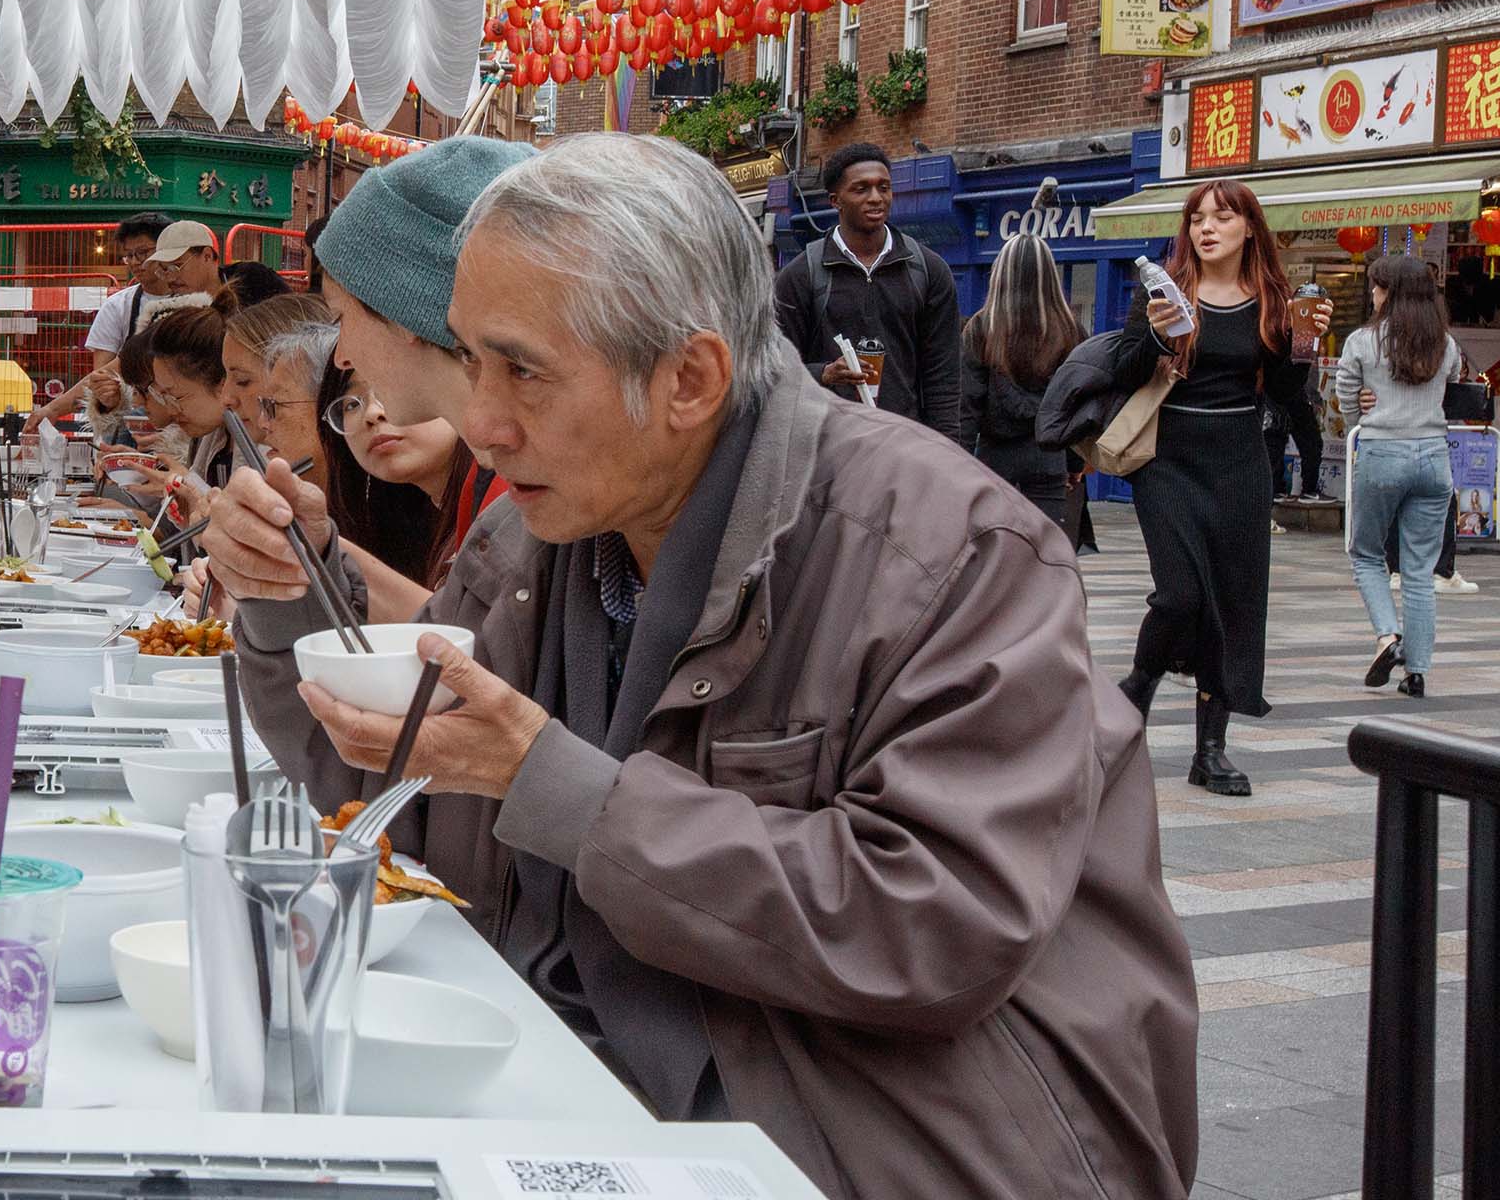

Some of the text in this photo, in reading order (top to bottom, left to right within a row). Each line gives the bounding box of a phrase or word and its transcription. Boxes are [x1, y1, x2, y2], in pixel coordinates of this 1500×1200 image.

[1332, 84, 1352, 115] 仙
[1204, 88, 1239, 158] 福
[1332, 113, 1350, 129] ZEN
[69, 183, 162, 200] SPECIALIST
[1301, 201, 1453, 223] CHINESE ART AND FASHIONS
